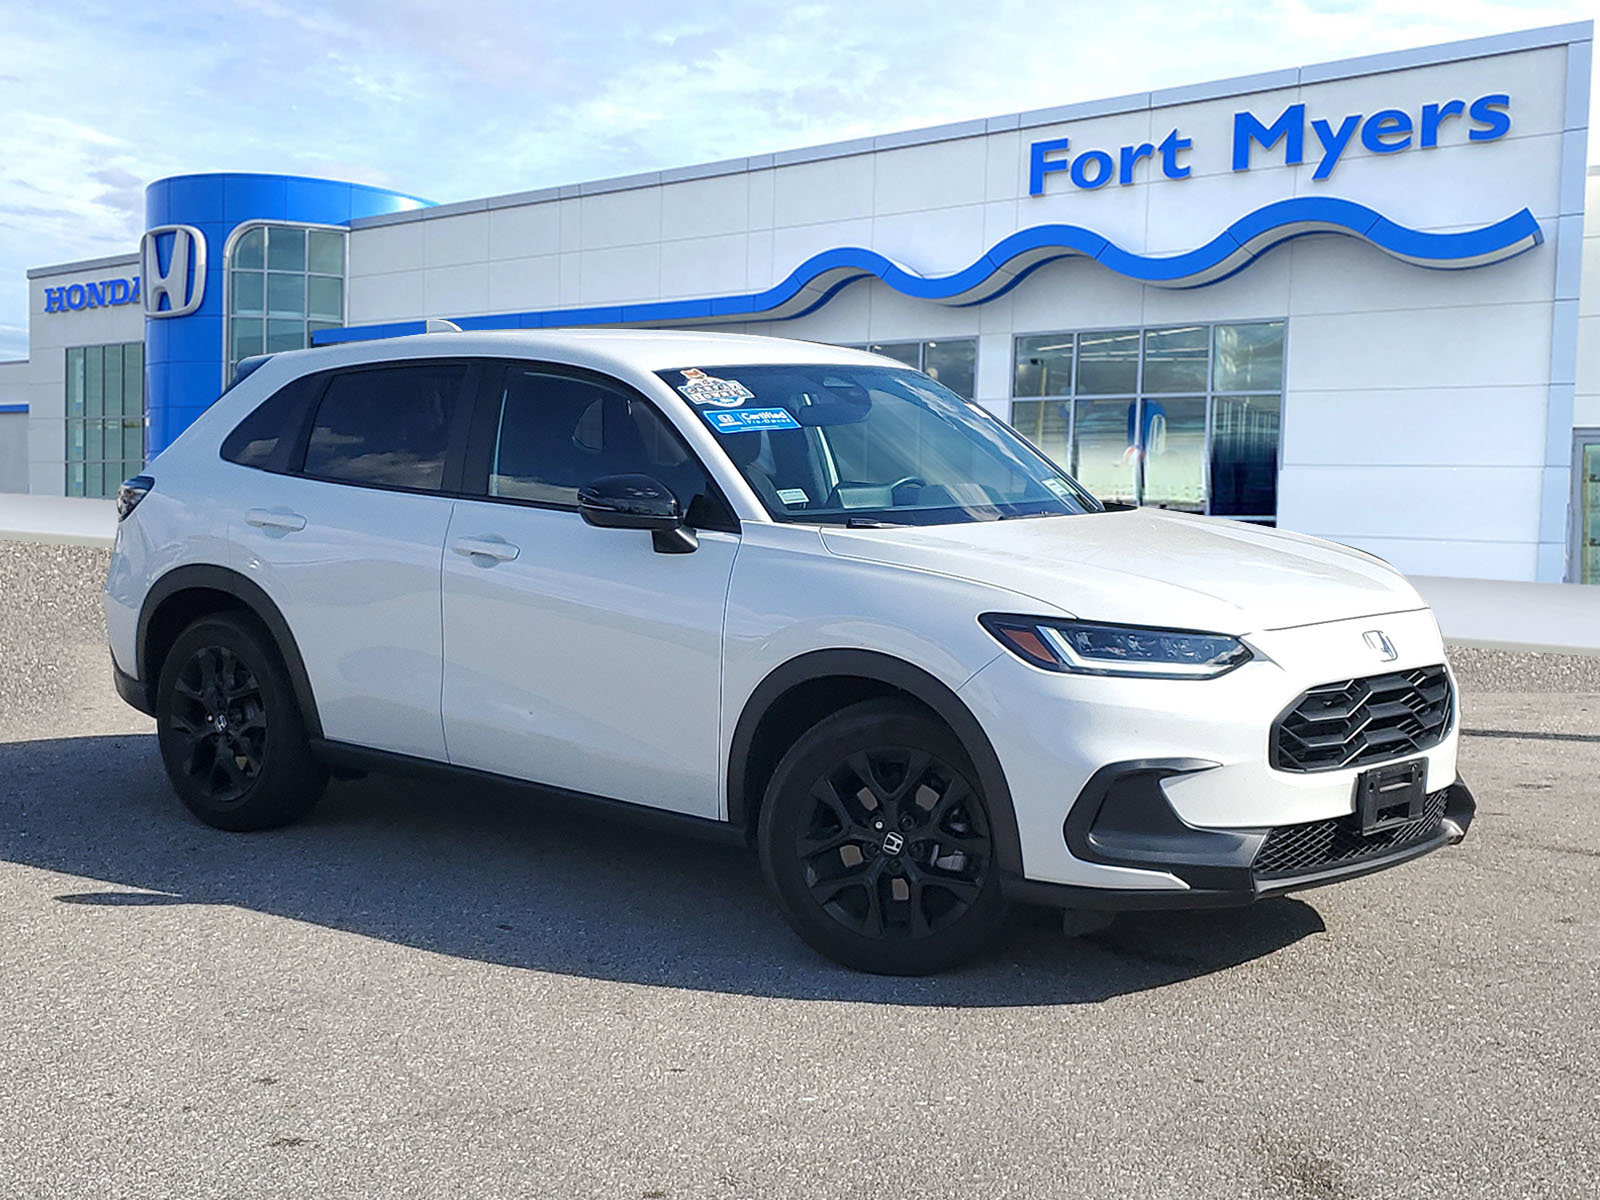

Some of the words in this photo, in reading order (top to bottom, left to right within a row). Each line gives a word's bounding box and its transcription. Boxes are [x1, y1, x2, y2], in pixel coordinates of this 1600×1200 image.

[1028, 128, 1192, 196] Fort
[1231, 93, 1511, 181] Myers
[741, 411, 788, 420] Certified
